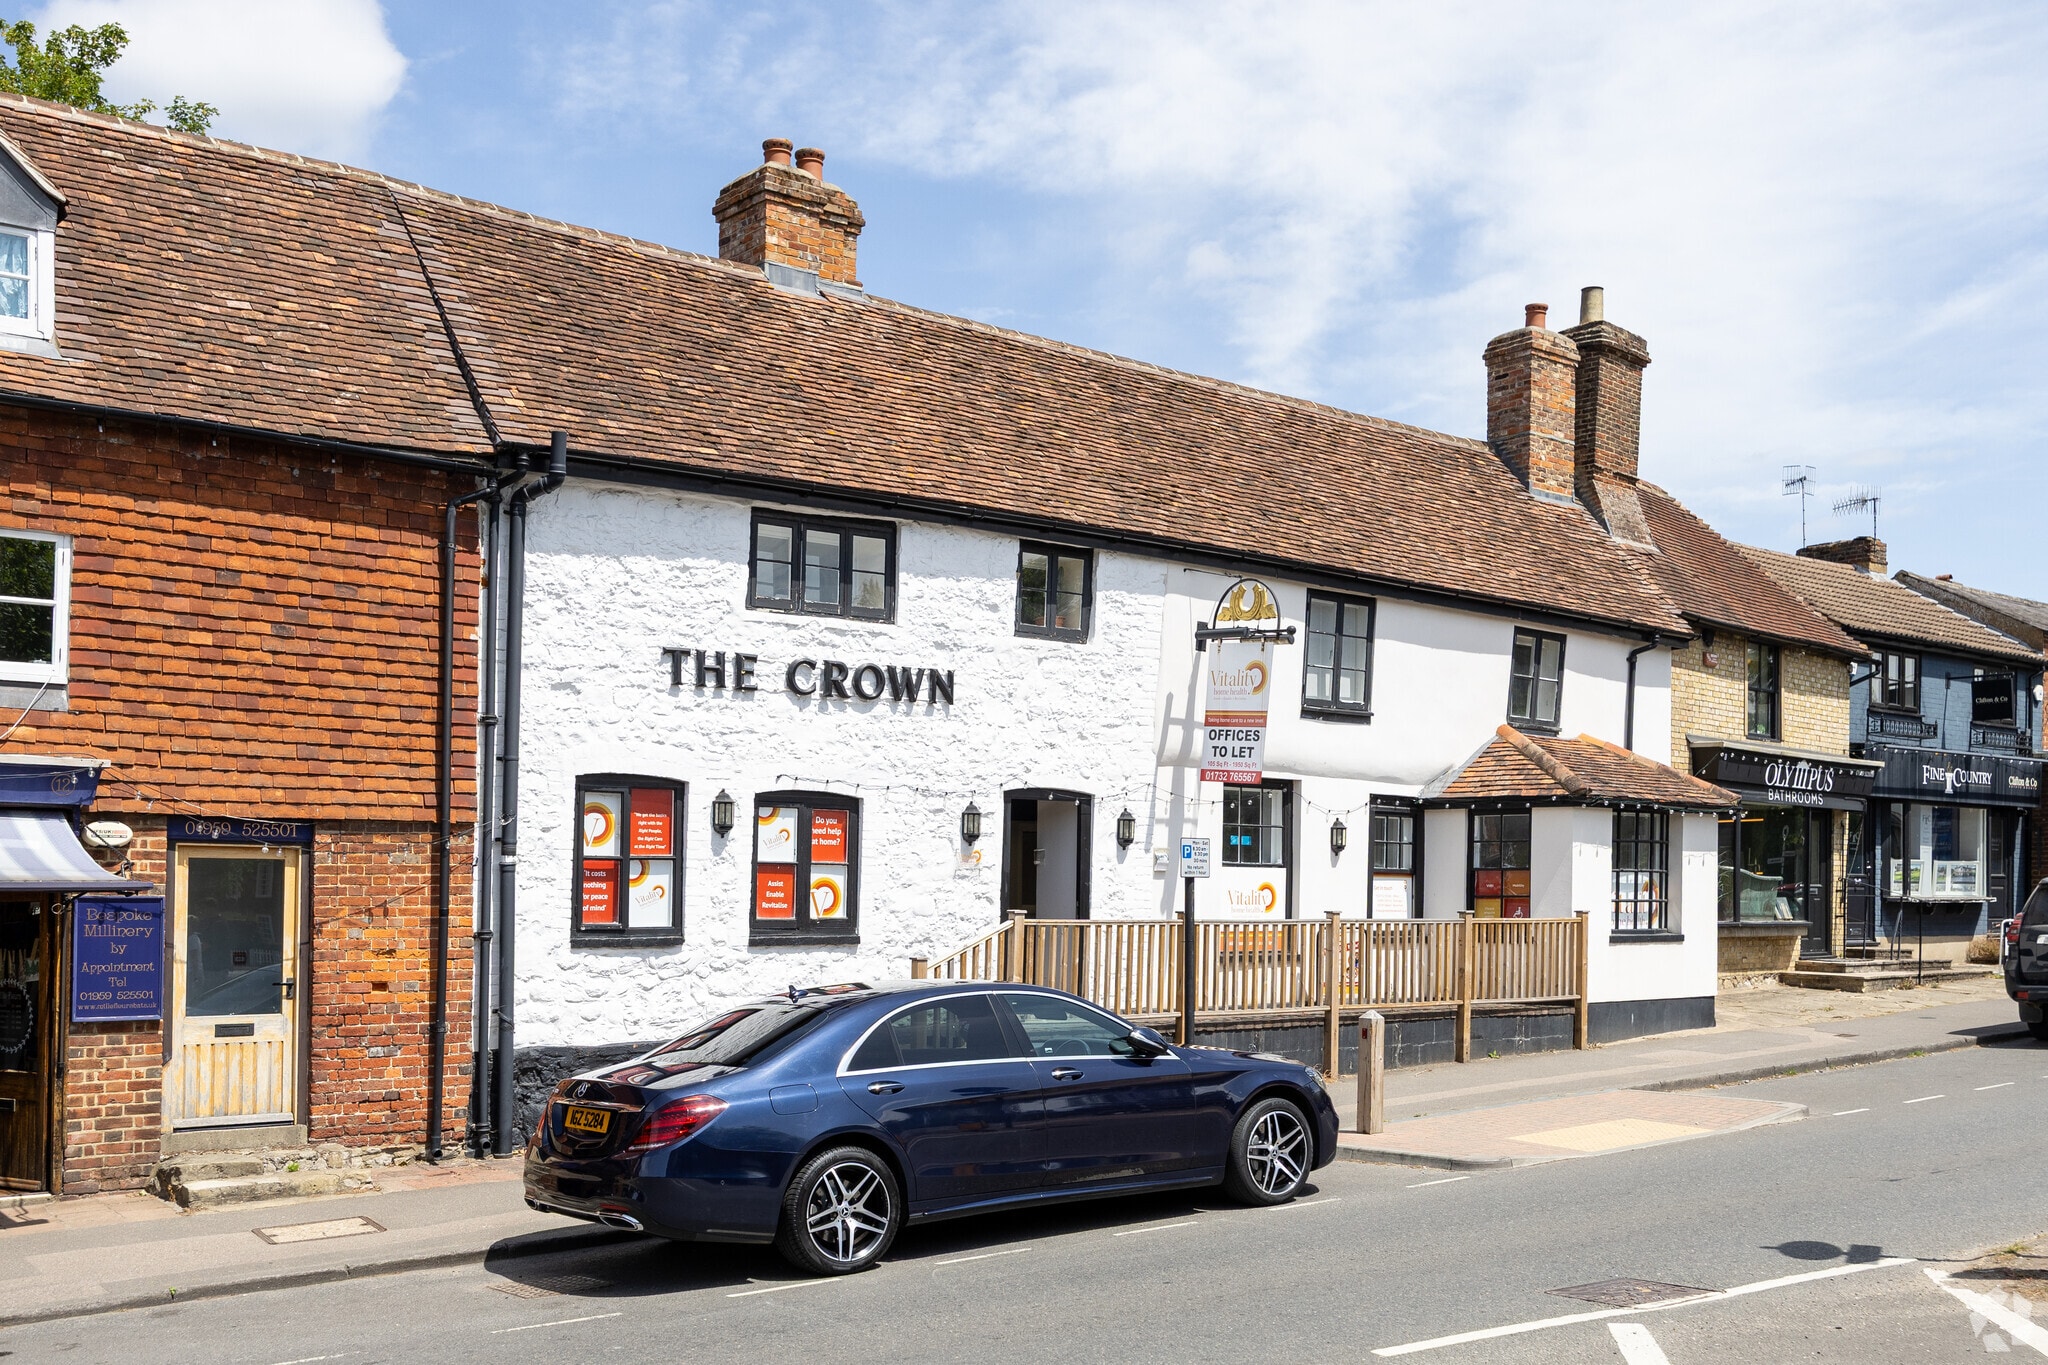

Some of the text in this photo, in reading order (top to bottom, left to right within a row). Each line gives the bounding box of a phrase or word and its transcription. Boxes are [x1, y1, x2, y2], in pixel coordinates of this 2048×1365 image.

[662, 646, 956, 706] THE CROWN
[1211, 669, 1257, 688] Vitality
[1213, 687, 1229, 695] home
[1208, 729, 1260, 742] OFFICES
[1212, 746, 1254, 758] TO LET
[1206, 771, 1256, 782] 01732 765567
[1765, 761, 1835, 792] OLYMPUS
[1922, 765, 1992, 787] FINE COUNTRY
[2025, 777, 2030, 786] &
[2031, 777, 2038, 787] Co
[56, 778, 71, 792] 12
[1768, 788, 1824, 805] BATHROOMS
[815, 816, 838, 826] Do you
[242, 822, 298, 837] 525501
[827, 827, 842, 837] help
[819, 838, 841, 846] home?
[583, 881, 606, 890] nothing
[591, 893, 608, 902] peace
[766, 890, 785, 898] Enable
[1228, 889, 1268, 906] Vitality
[761, 901, 788, 909] Revitalise
[86, 908, 152, 923] Bespoke
[83, 924, 154, 938] Millinery
[110, 942, 127, 954] by
[81, 962, 155, 975] Appointment
[108, 977, 127, 987] Tel
[80, 990, 154, 1001] 01959 525501
[583, 1111, 606, 1130] 5284
